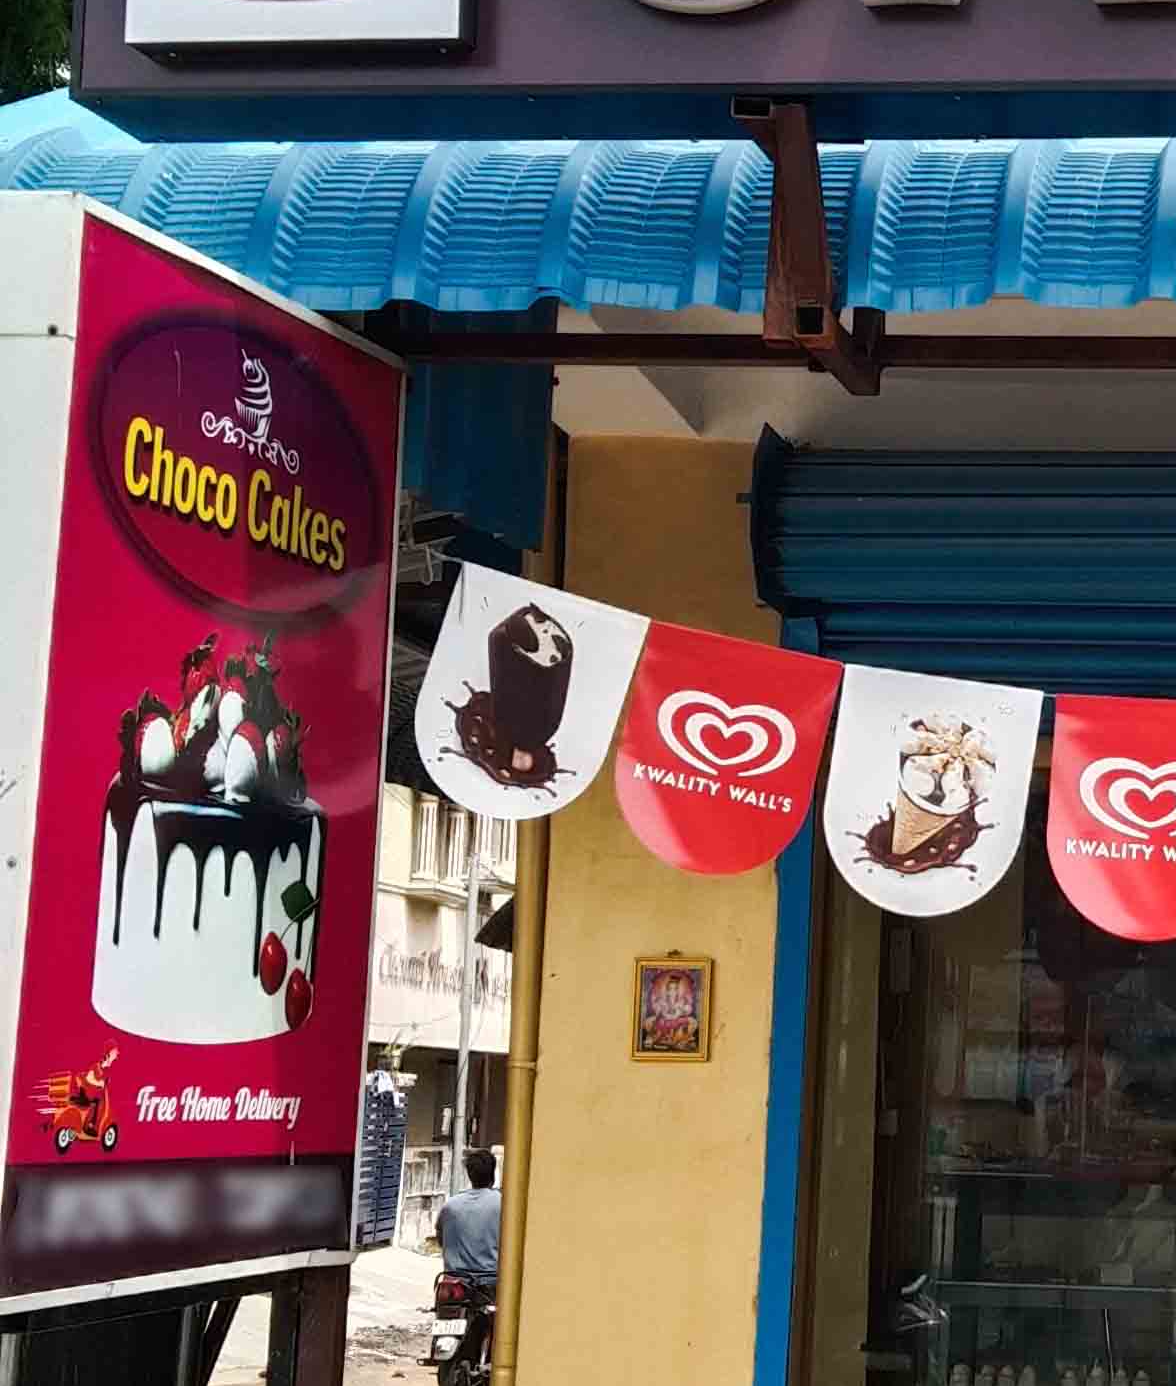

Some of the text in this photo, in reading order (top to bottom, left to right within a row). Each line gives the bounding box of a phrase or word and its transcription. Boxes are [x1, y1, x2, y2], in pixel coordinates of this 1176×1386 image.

[124, 416, 347, 572] Choco Cakes
[632, 762, 793, 813] KWALITY WALL'S
[1065, 837, 1155, 861] KWALITY
[136, 1085, 301, 1130] Free Home Delivery
